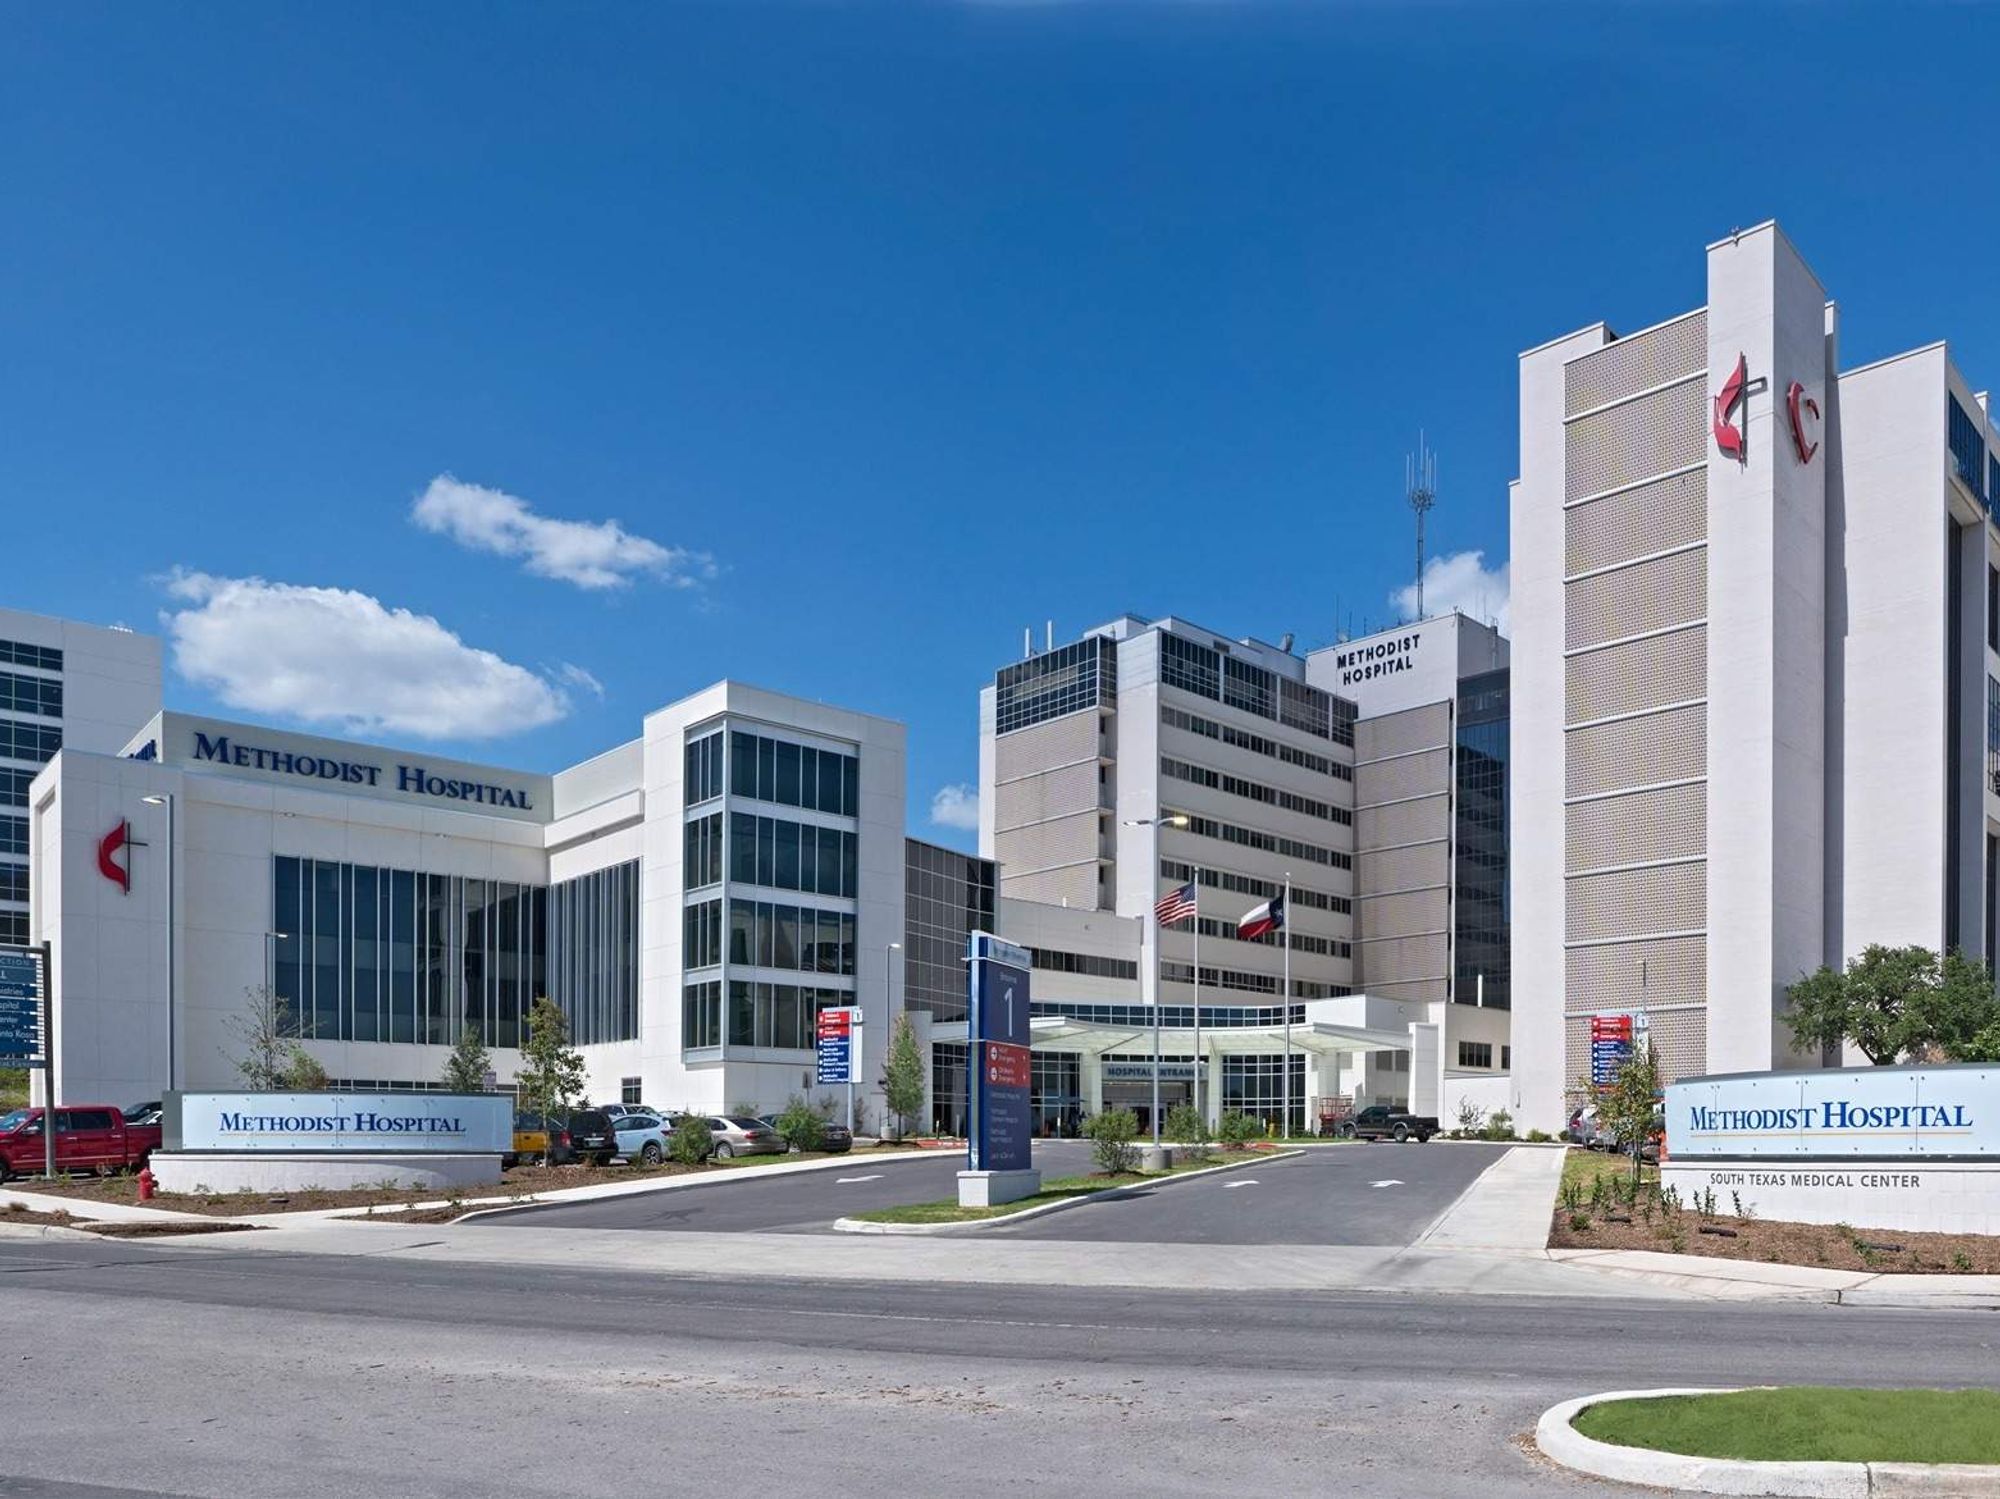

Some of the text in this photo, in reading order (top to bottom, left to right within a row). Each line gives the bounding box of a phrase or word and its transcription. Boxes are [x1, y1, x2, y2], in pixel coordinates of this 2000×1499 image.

[1337, 634, 1420, 669] METHODIST
[1343, 656, 1412, 685] HOSPITAL
[193, 731, 382, 787] METHODIST
[397, 764, 533, 811] HOSPITAL
[1004, 987, 1013, 1037] 1
[1108, 1067, 1152, 1077] HOSPITAL
[220, 1113, 467, 1133] METHODIST HOSPITAL
[1690, 1102, 1973, 1131] METHODIST HOSPITAL
[1711, 1173, 1920, 1188] SOUTH TEXAS MEDICAL CENTER
